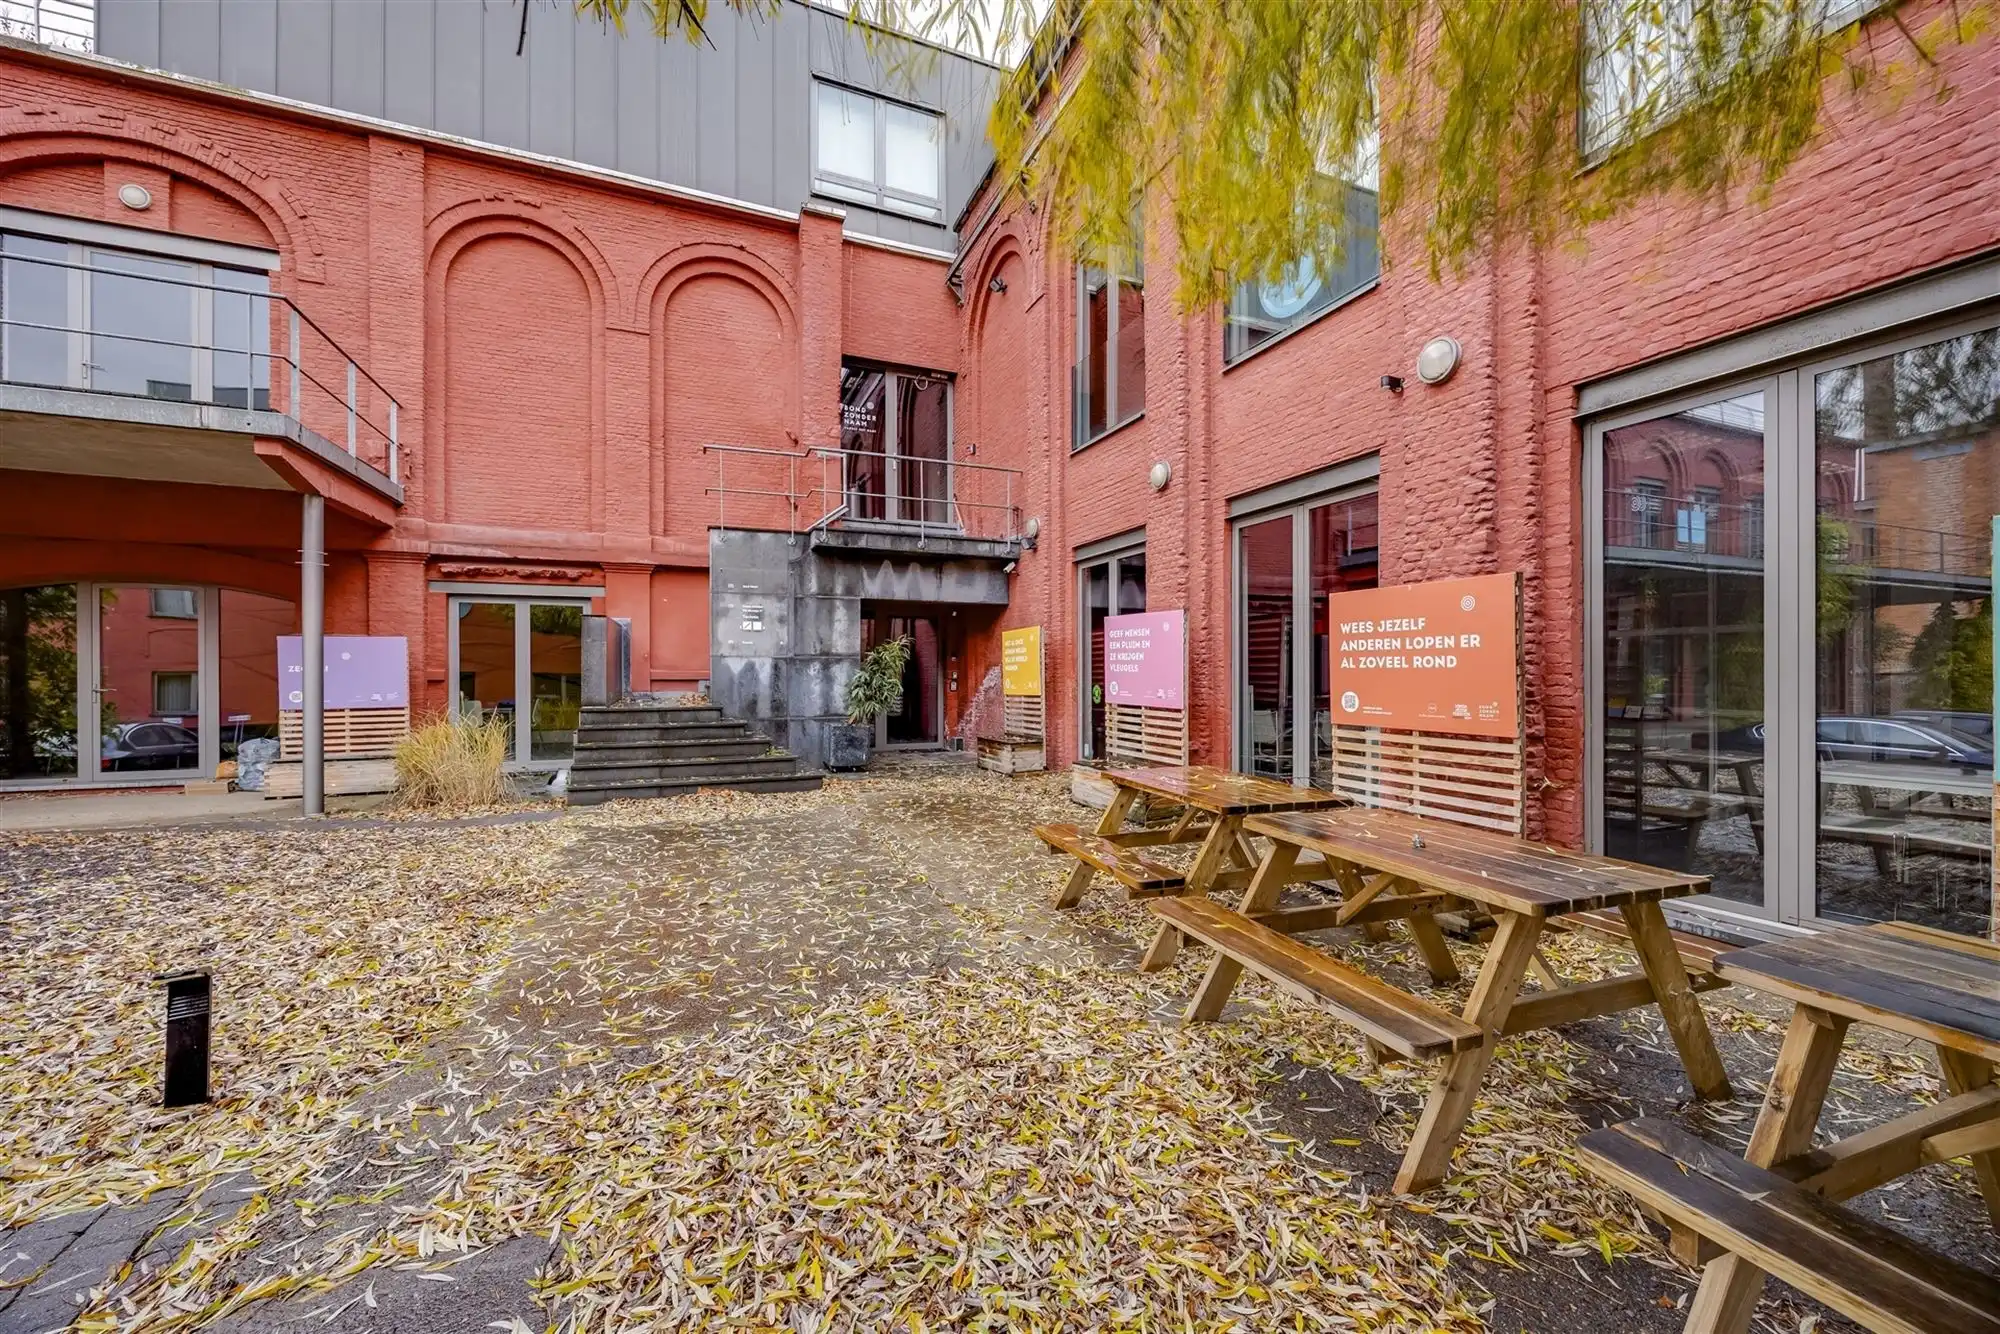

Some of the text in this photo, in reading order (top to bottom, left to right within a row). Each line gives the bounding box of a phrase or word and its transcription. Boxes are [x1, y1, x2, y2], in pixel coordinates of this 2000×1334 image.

[844, 405, 866, 413] BOND
[844, 412, 876, 421] ZONDER
[1340, 617, 1426, 634] WEES JEZELF
[1109, 628, 1150, 638] GEEF MENSEN
[1109, 640, 1150, 649] EEN PLUIM EN
[1340, 634, 1480, 651] ANDEREN LOPEN ER
[1118, 652, 1144, 660] KRIJGEN
[1340, 655, 1457, 668] AL ZOVEEL ROND
[1110, 664, 1139, 672] VLEUGELS
